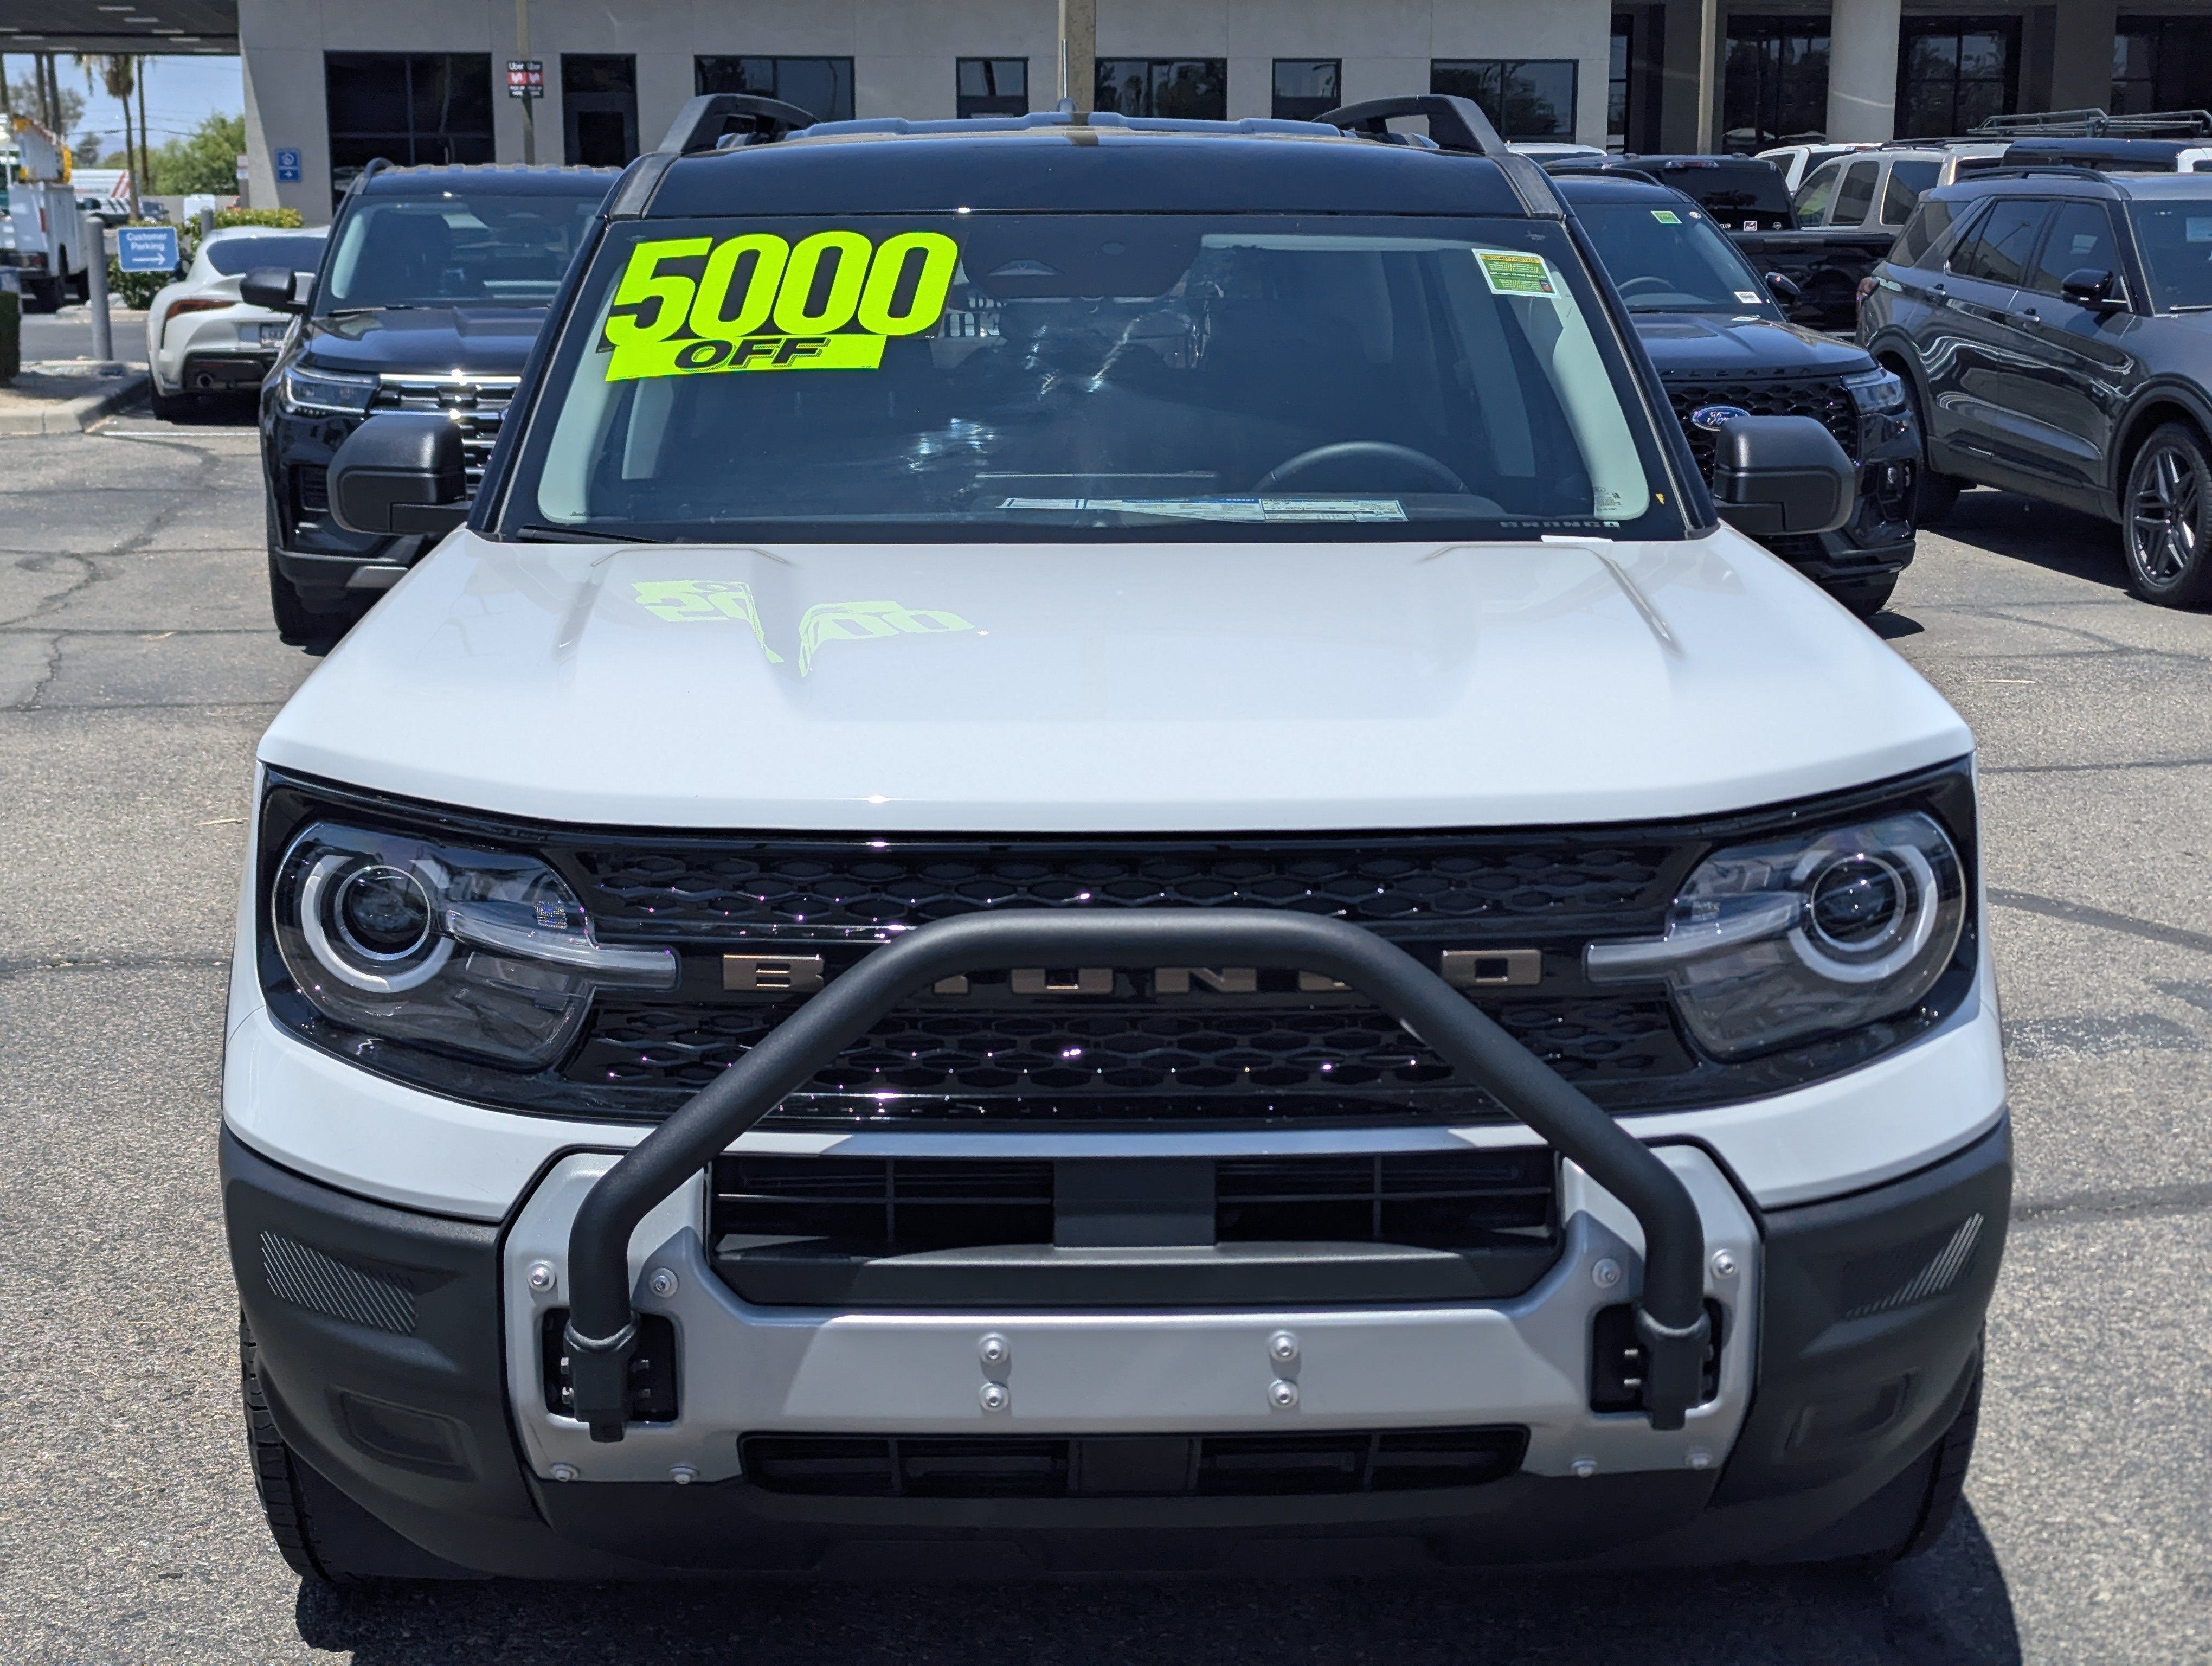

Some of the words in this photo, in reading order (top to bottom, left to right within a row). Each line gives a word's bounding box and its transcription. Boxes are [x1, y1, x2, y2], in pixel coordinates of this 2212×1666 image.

[126, 233, 167, 241] Customer
[131, 242, 165, 251] Parking
[605, 230, 958, 346] 5000
[674, 337, 831, 373] OFF
